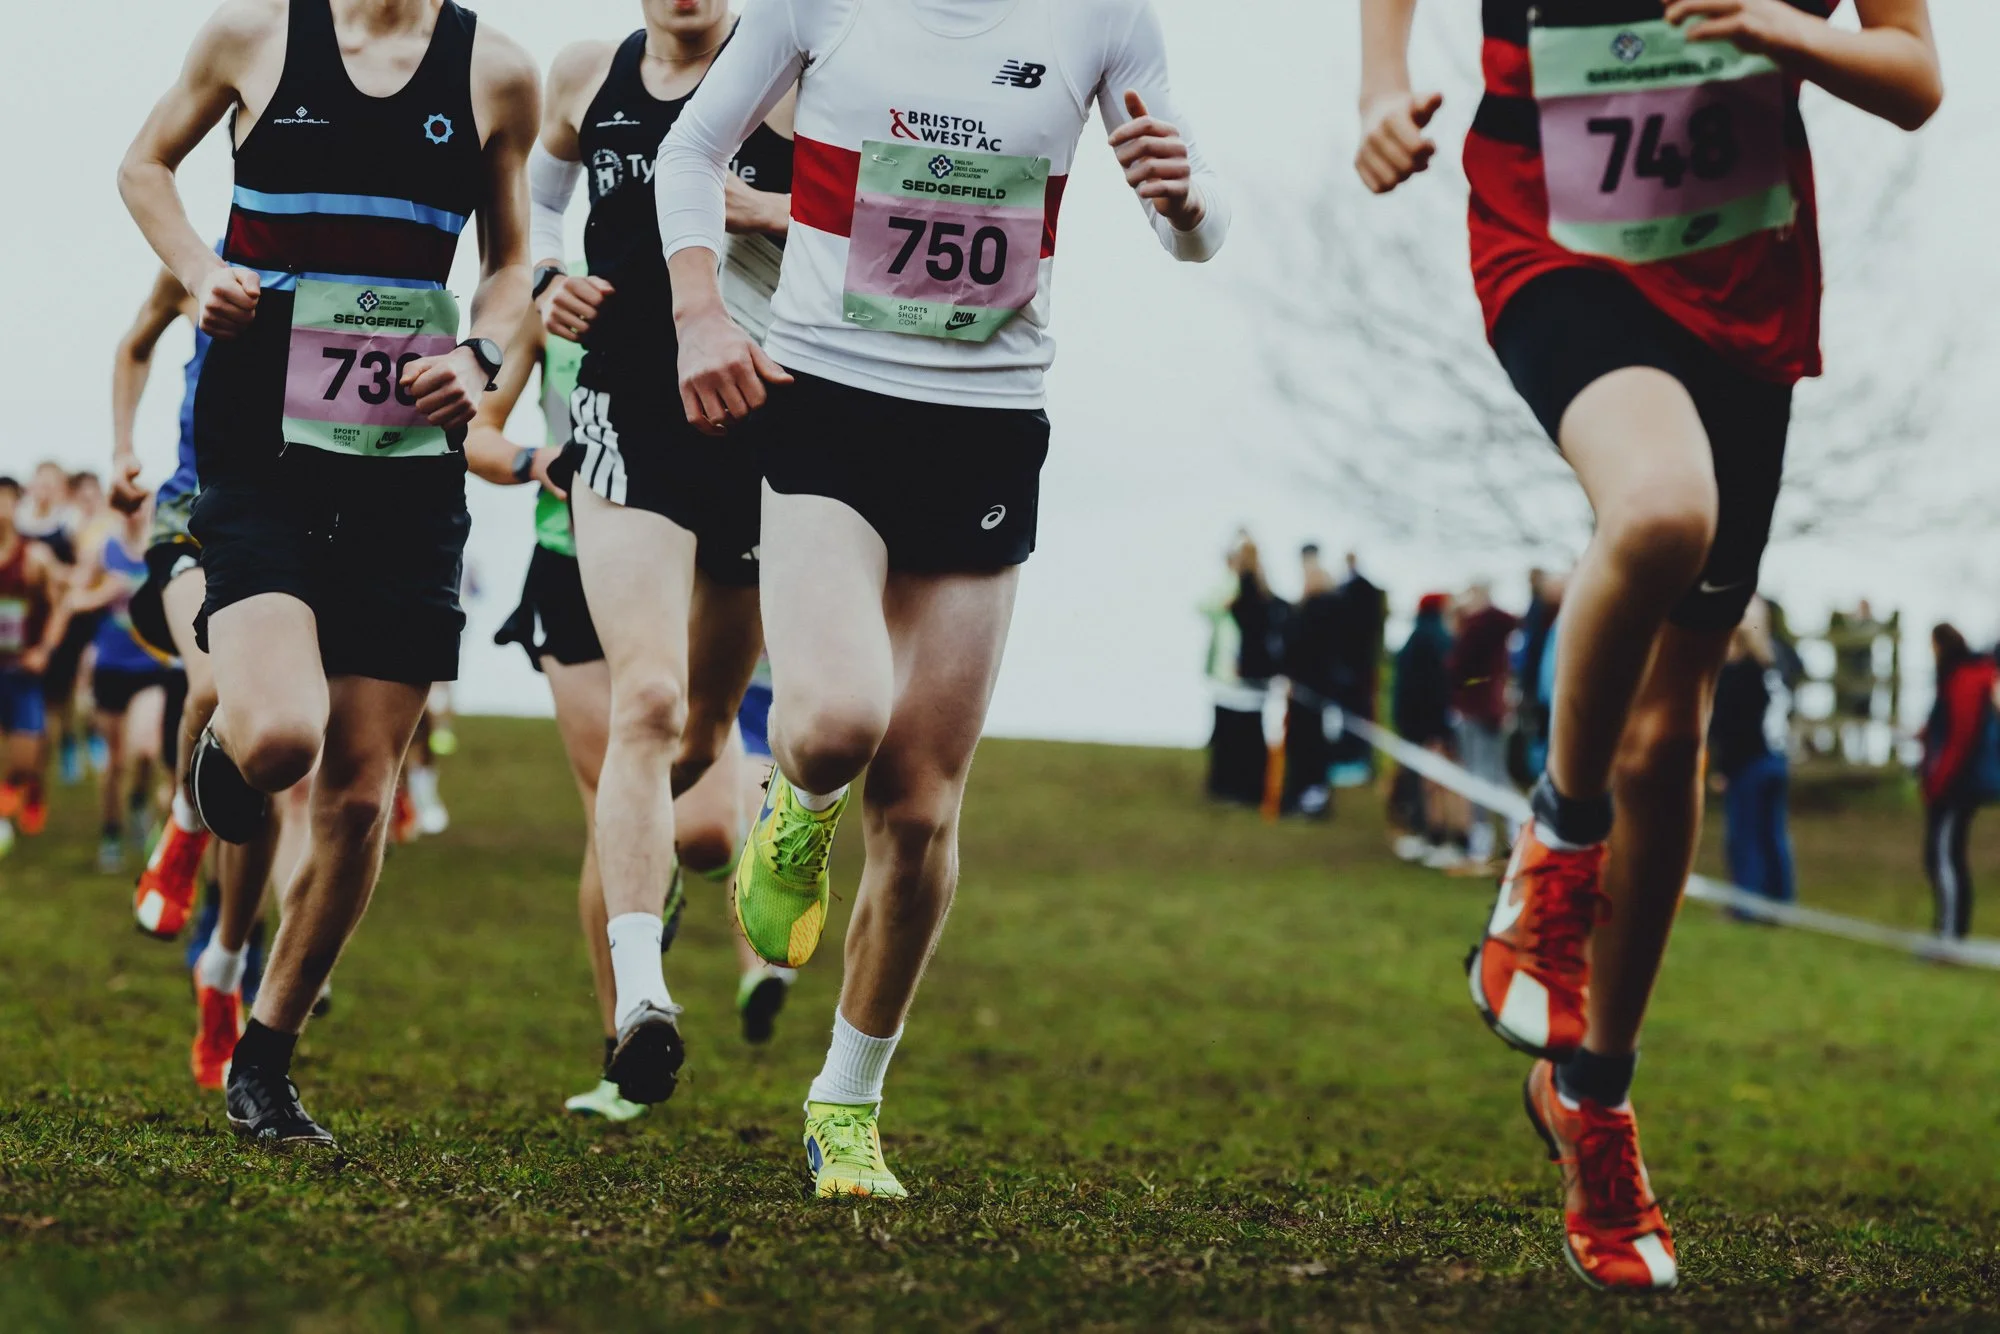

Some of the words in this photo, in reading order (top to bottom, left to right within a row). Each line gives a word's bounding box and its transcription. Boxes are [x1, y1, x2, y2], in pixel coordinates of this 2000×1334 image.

[907, 110, 986, 134] BRISTOL
[920, 127, 972, 148] WEST
[976, 137, 1002, 152] AC
[1587, 104, 1738, 193] 748
[902, 179, 1006, 199] SEDGEFIELD
[887, 216, 1008, 285] 750
[897, 311, 923, 321] SHOES
[898, 304, 928, 314] SPORTS
[333, 314, 424, 328] SEDGEFIELD
[952, 311, 976, 322] RUN
[332, 434, 356, 442] SHOES
[333, 428, 360, 436] SPORTS
